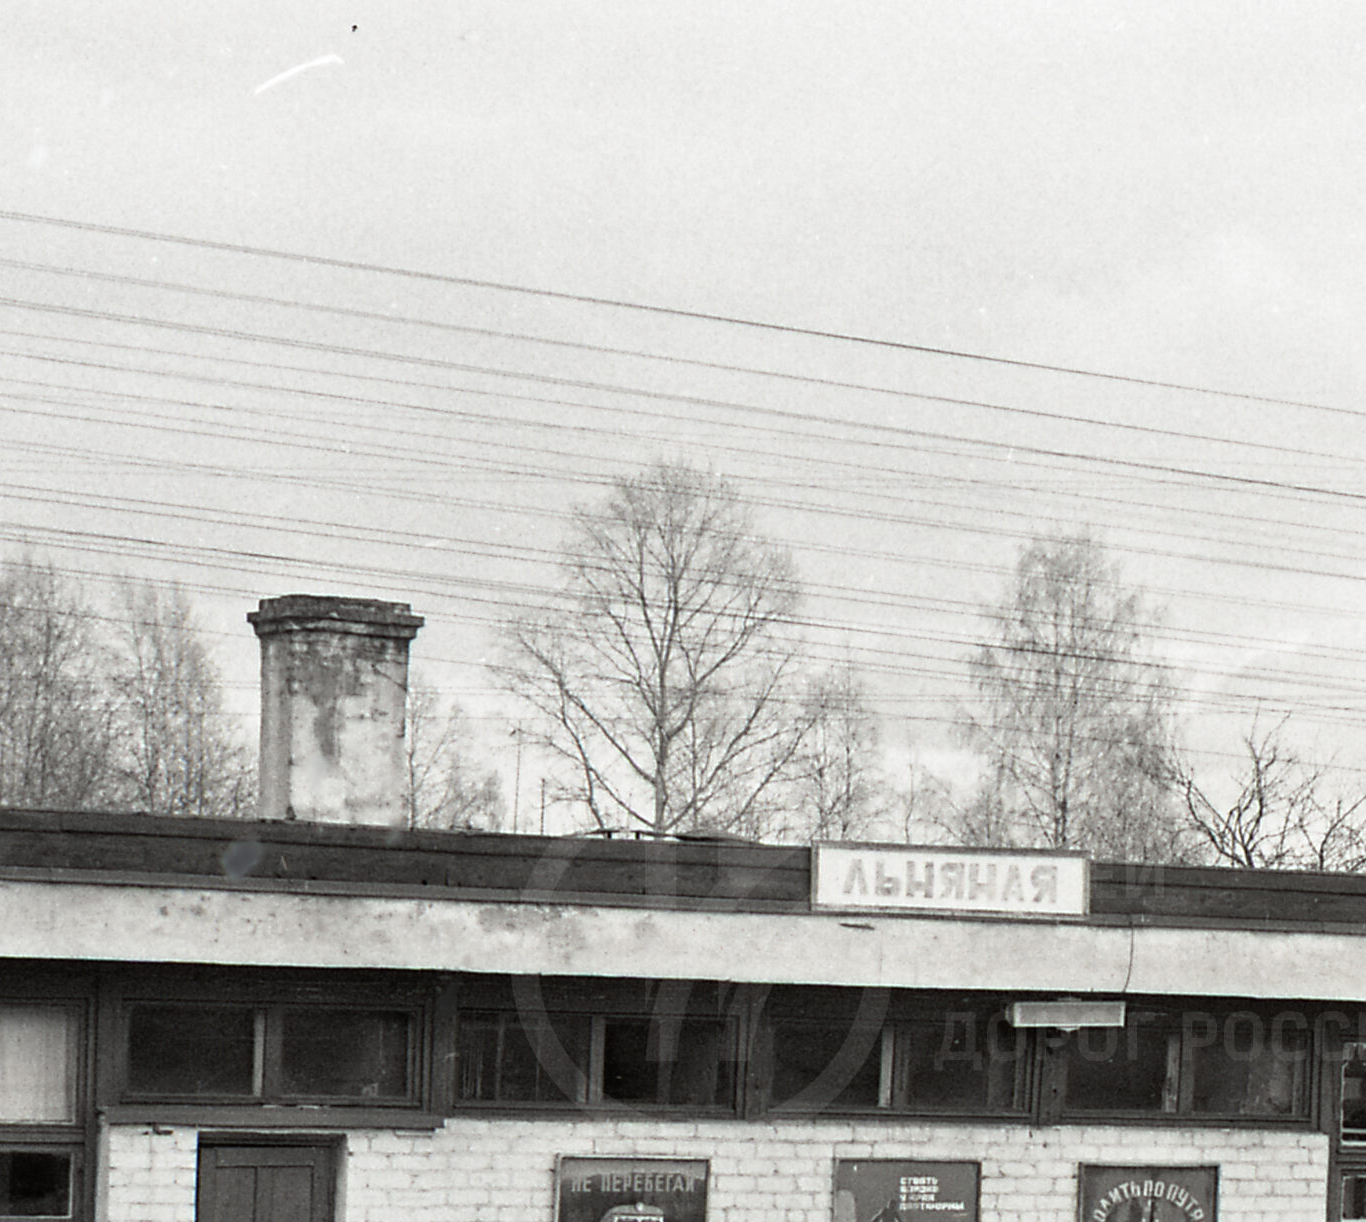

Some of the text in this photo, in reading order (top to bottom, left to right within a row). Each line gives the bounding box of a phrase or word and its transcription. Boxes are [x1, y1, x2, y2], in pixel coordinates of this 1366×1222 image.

[841, 858, 1059, 904] ЛЬНЯНАЯ
[571, 1174, 592, 1193] НЕ
[1143, 1179, 1165, 1198] ПО
